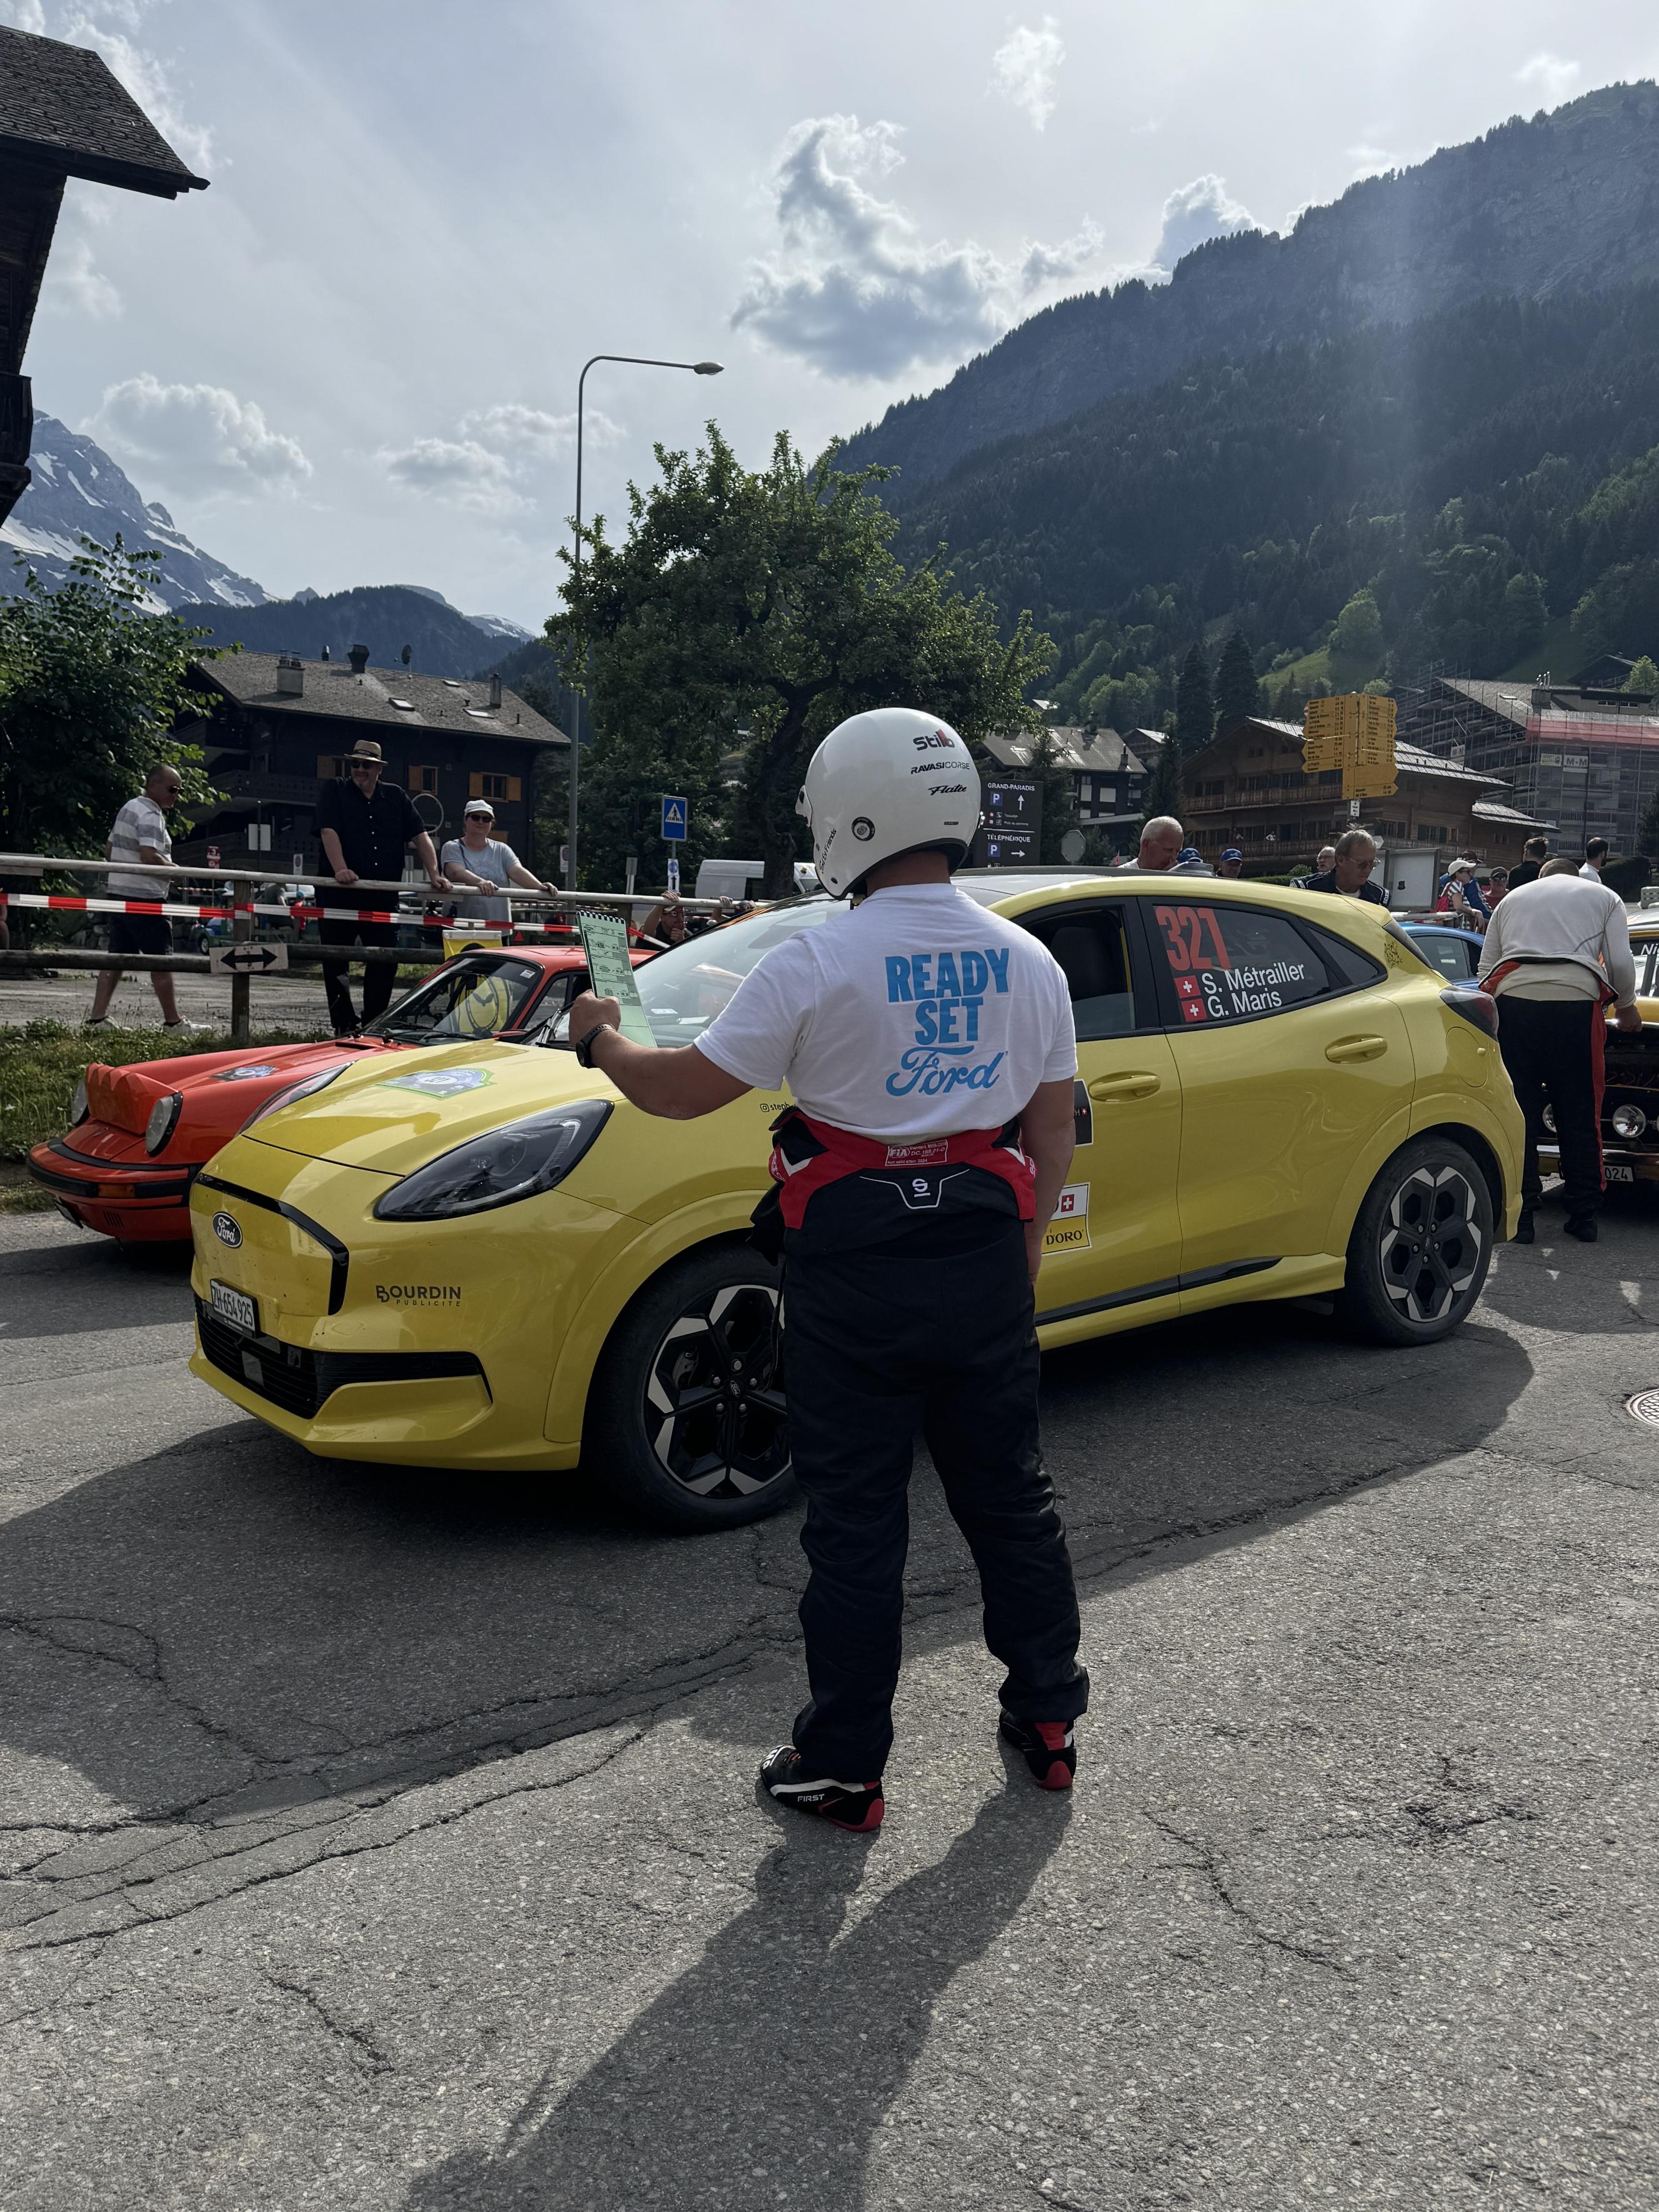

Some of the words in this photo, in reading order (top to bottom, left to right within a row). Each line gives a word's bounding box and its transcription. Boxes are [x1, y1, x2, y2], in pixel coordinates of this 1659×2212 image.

[910, 762, 970, 774] RAVASICORSE
[987, 782, 1035, 791] GRAND-PARADIS
[993, 793, 1000, 804] P
[990, 844, 997, 855] P
[1155, 906, 1231, 971] 321
[1641, 943, 1659, 955] Ni
[885, 949, 1009, 1002] READY
[1201, 972, 1222, 994] S.
[1225, 962, 1305, 991] Métrailler
[1207, 996, 1229, 1018] G.
[1231, 988, 1282, 1014] Maris
[915, 997, 984, 1045] SET
[886, 1045, 1005, 1096] Ford
[217, 1217, 236, 1243] Ford
[376, 1285, 461, 1303] BOURDIN
[797, 1794, 825, 1802] FIRST
